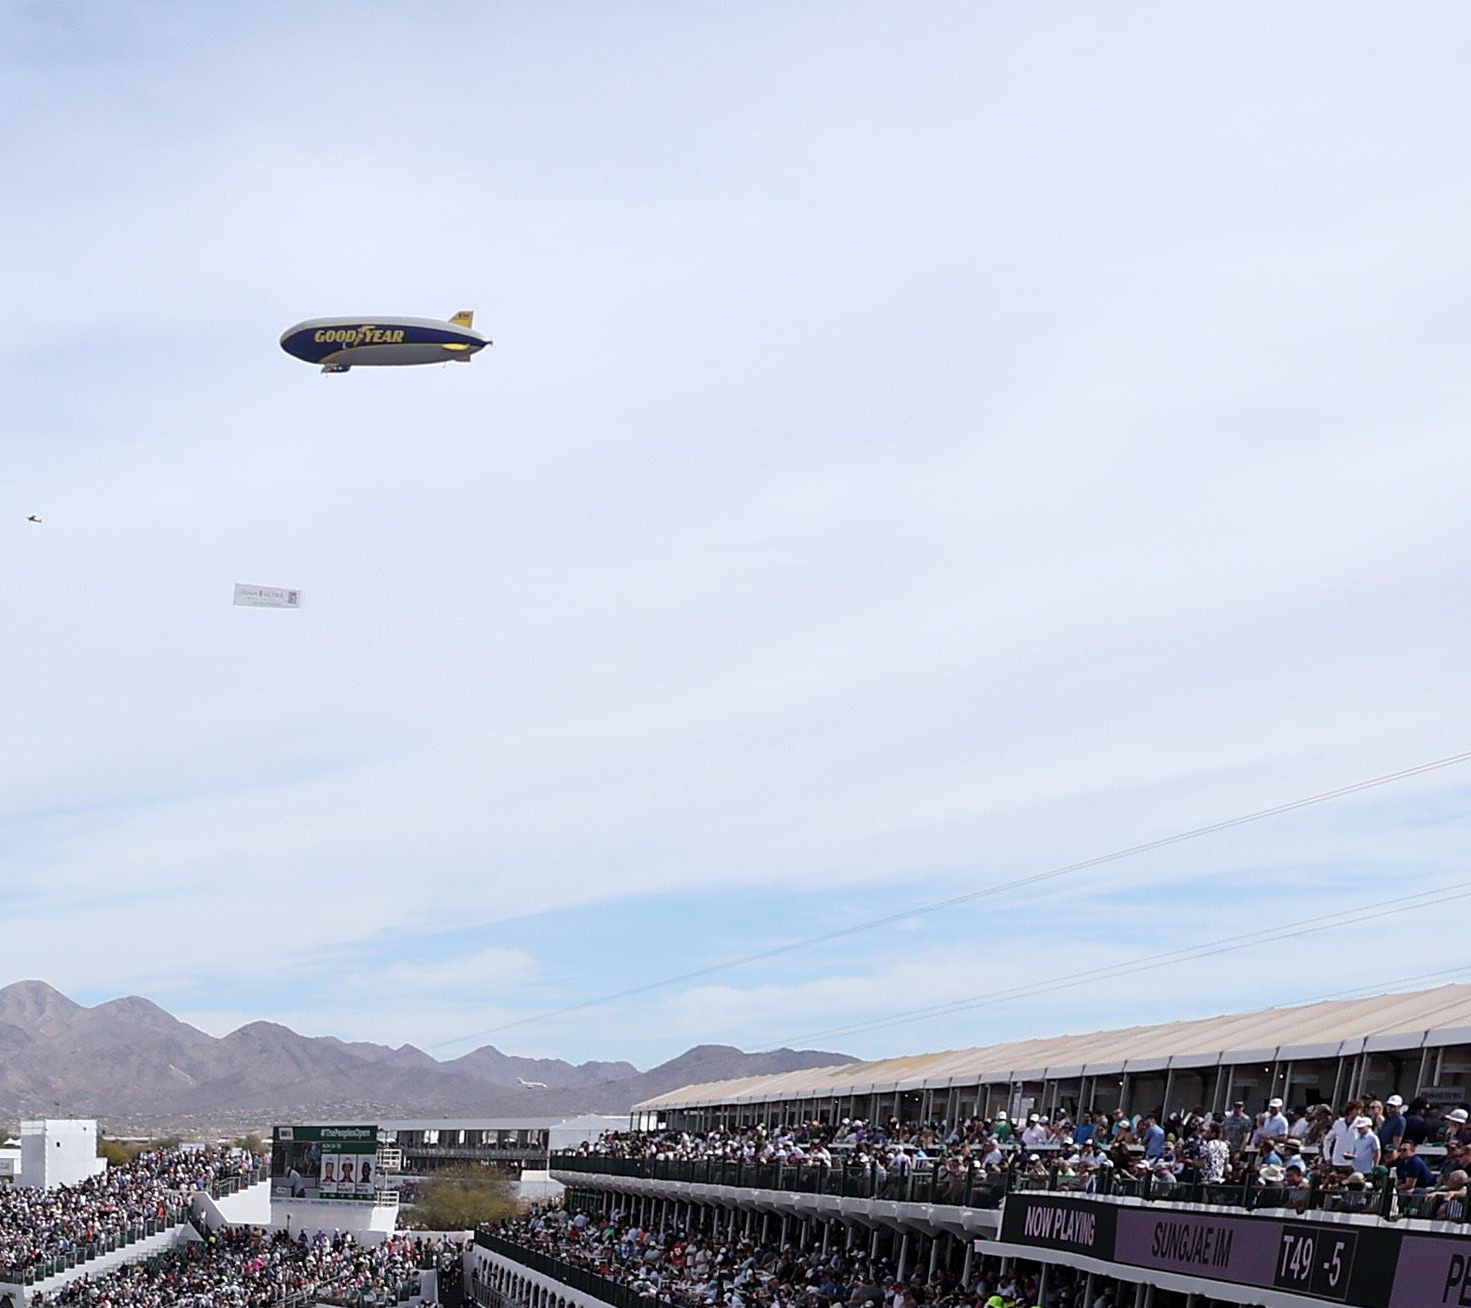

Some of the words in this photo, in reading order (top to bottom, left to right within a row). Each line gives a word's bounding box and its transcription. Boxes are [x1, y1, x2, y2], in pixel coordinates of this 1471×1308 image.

[314, 326, 404, 344] GOODYEAR
[1024, 1206, 1053, 1241] NOW
[1056, 1208, 1095, 1247] PLAYING
[1151, 1222, 1210, 1266] SUNGJAE
[1211, 1228, 1234, 1268] IM
[1280, 1235, 1313, 1281] T49
[1323, 1241, 1345, 1287] -5
